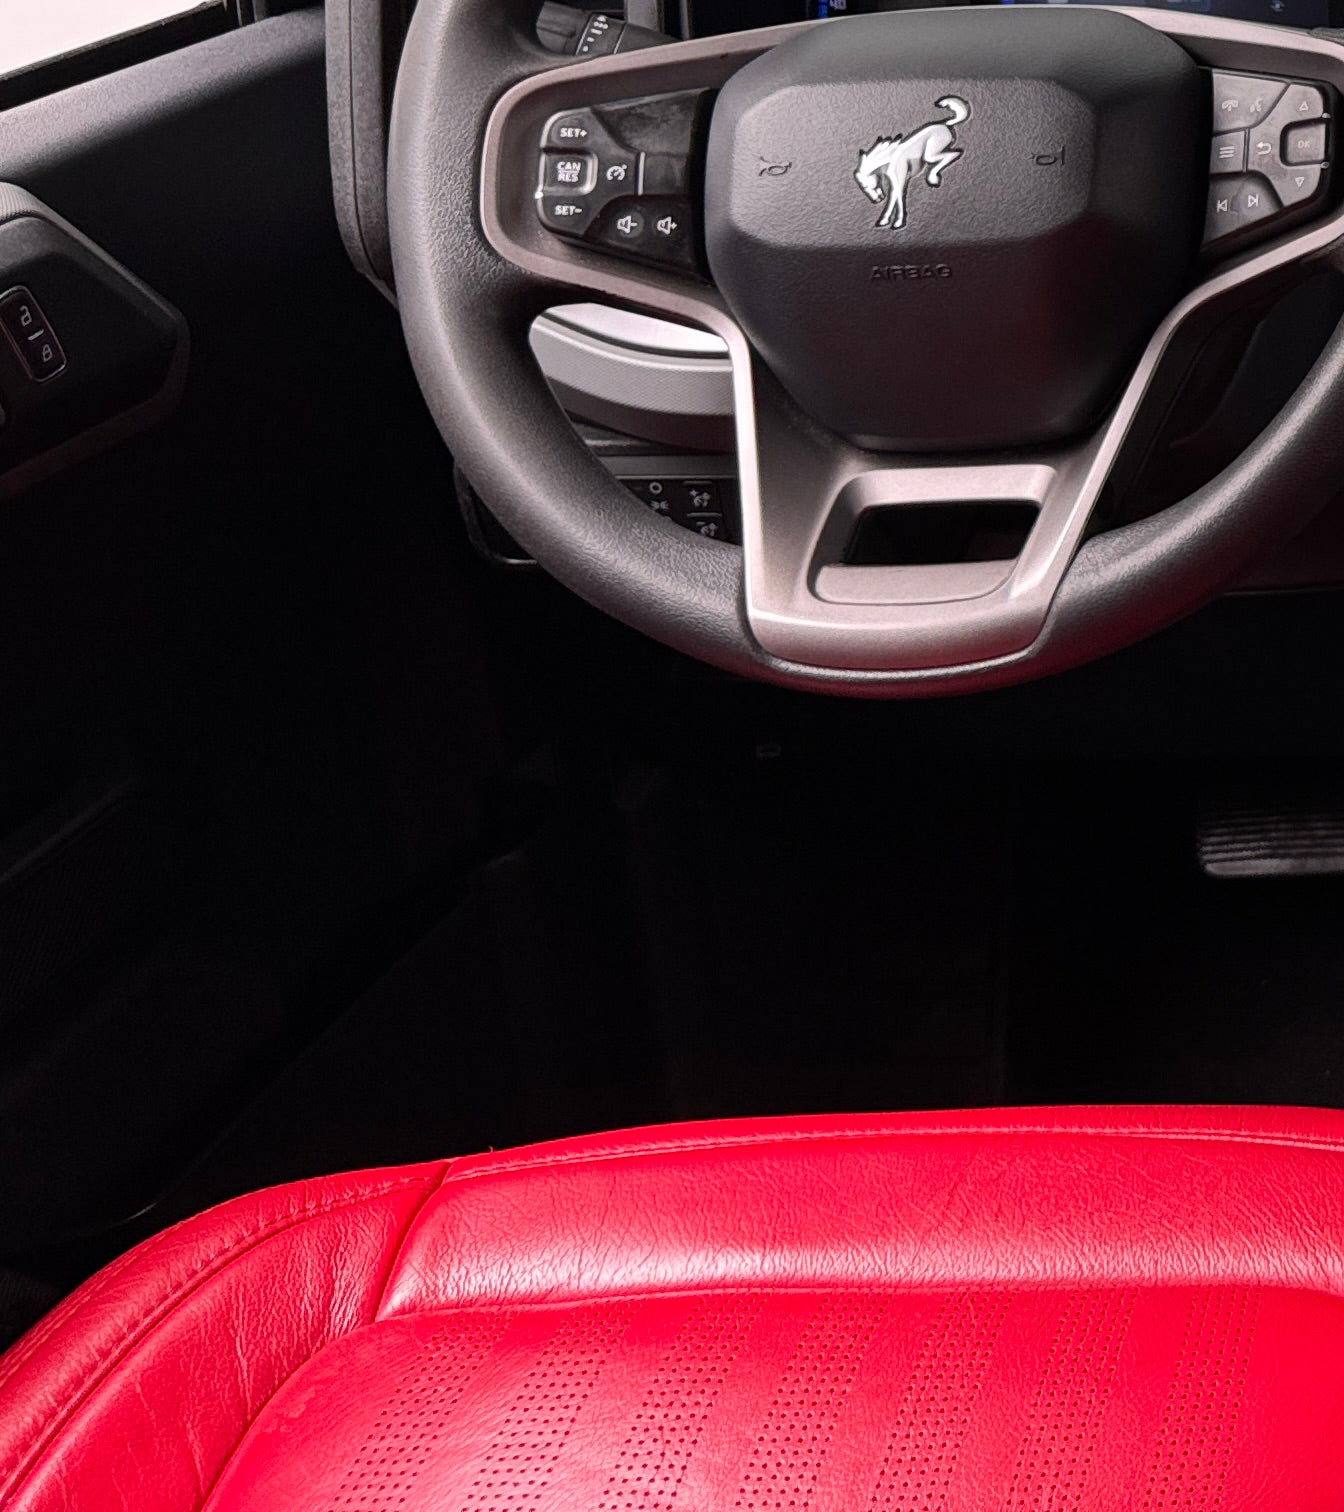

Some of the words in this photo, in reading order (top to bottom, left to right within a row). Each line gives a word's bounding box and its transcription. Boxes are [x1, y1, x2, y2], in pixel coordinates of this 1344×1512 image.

[1296, 138, 1311, 150] OK
[556, 160, 582, 171] CAN
[867, 263, 953, 283] AIRBAG
